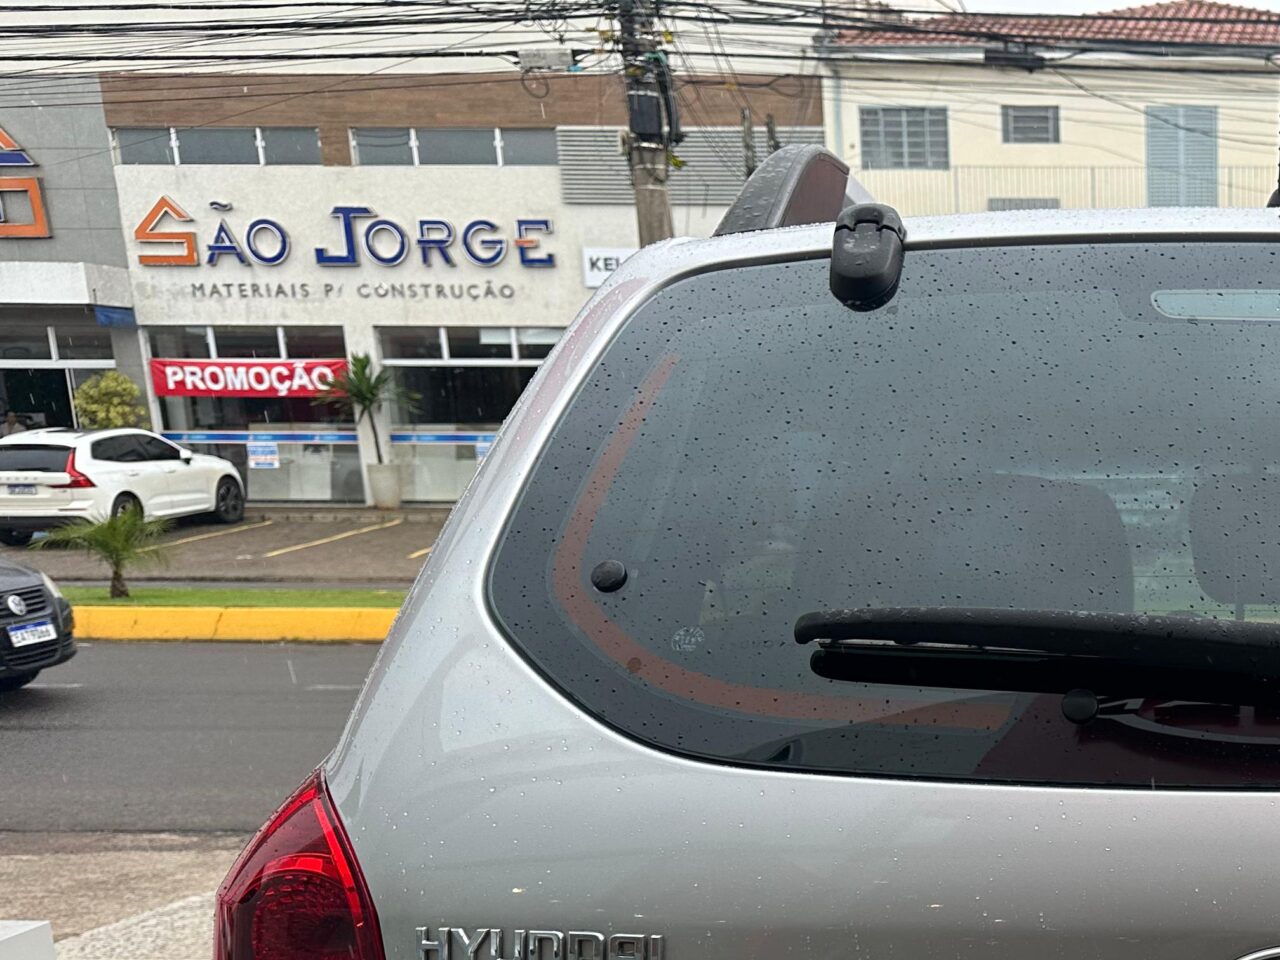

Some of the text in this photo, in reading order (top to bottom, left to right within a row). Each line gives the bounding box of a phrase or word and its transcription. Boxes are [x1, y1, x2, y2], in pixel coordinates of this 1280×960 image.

[134, 193, 557, 268] SÃO JORGE
[191, 278, 516, 302] MATERIAIS P/ CONSTRUÇÃO
[165, 361, 335, 397] PROMOÇÃO
